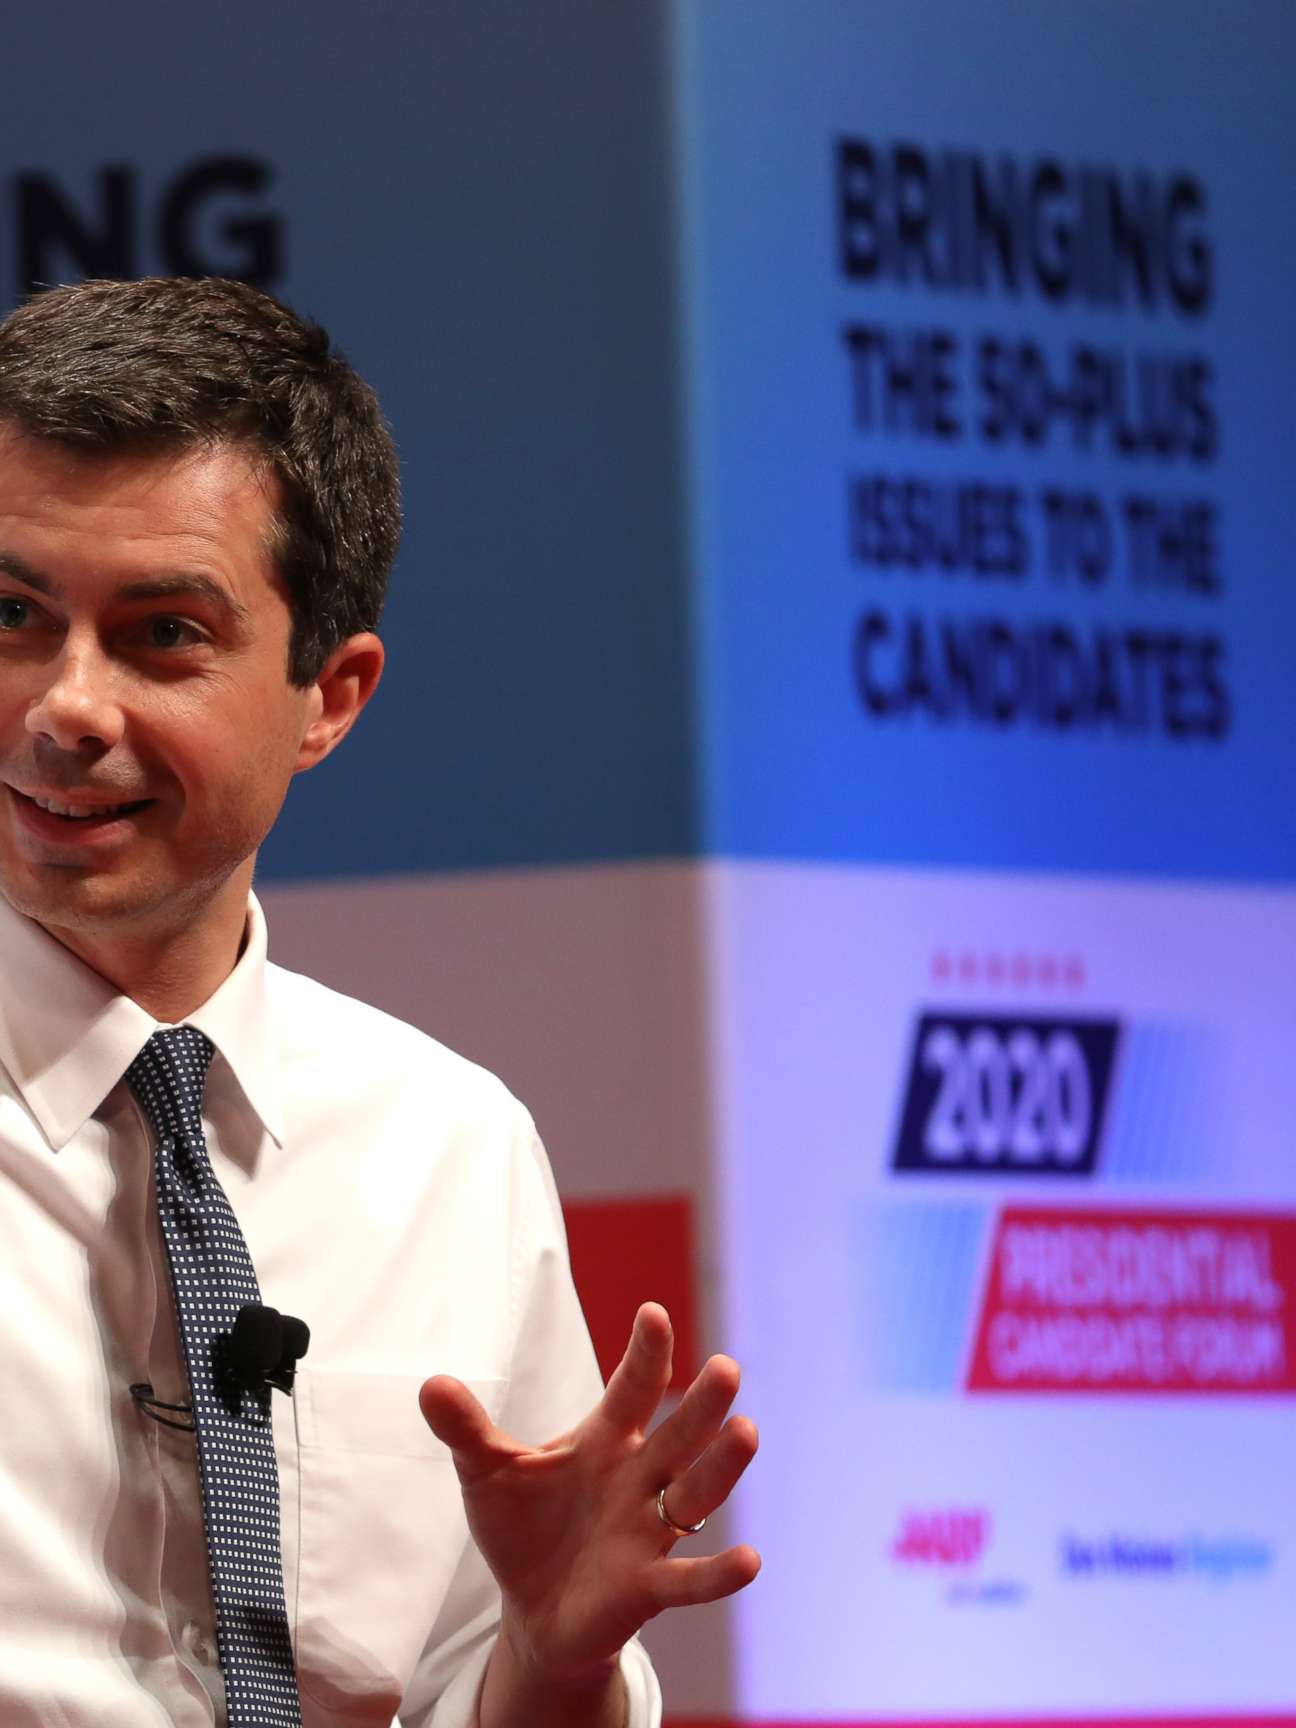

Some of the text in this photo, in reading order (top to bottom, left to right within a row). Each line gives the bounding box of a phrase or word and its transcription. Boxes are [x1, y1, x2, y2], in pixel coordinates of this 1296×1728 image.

[837, 137, 1216, 317] BRINGING
[845, 324, 1218, 465] THE 50-PLUS
[850, 473, 1221, 596] ISSUES TO THE
[854, 610, 1230, 743] CANDIDATES
[921, 1023, 1094, 1163] 2020
